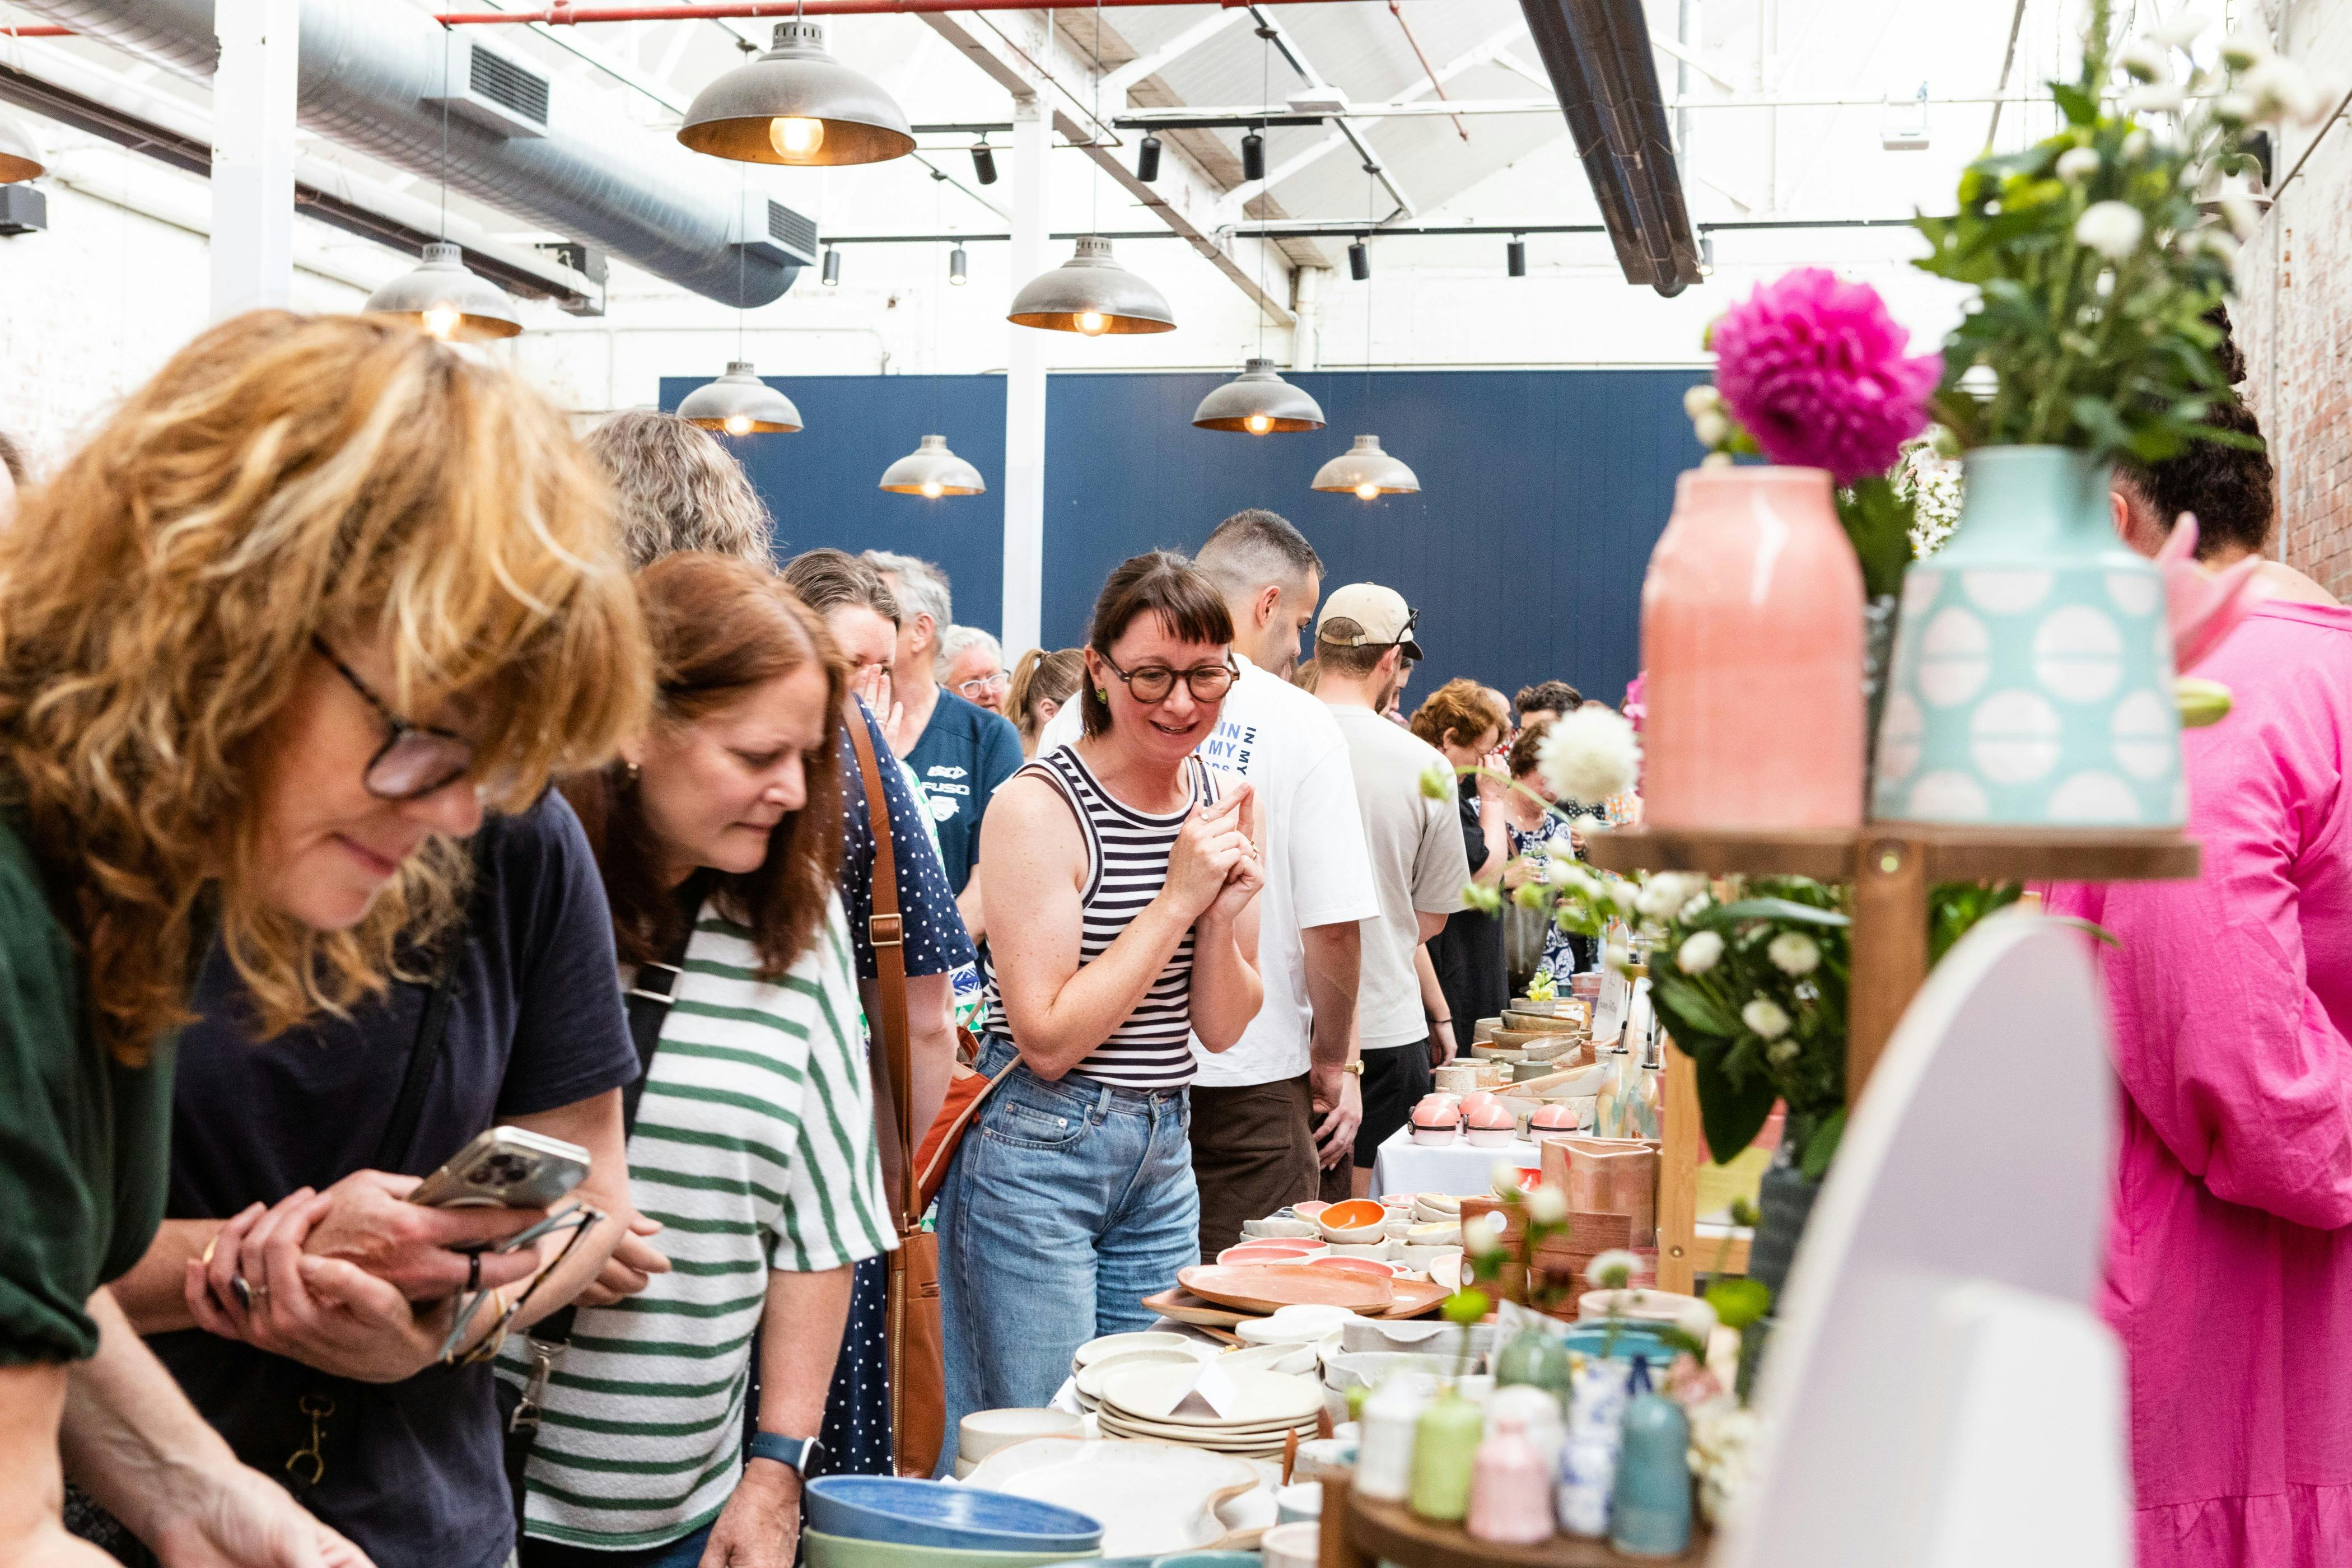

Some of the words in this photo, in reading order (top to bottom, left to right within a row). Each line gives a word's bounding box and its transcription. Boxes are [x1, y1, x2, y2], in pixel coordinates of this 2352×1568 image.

[1243, 726, 1257, 744] IN
[1208, 740, 1236, 758] MY
[1236, 750, 1250, 776] MY
[921, 781, 970, 795] FUSO
